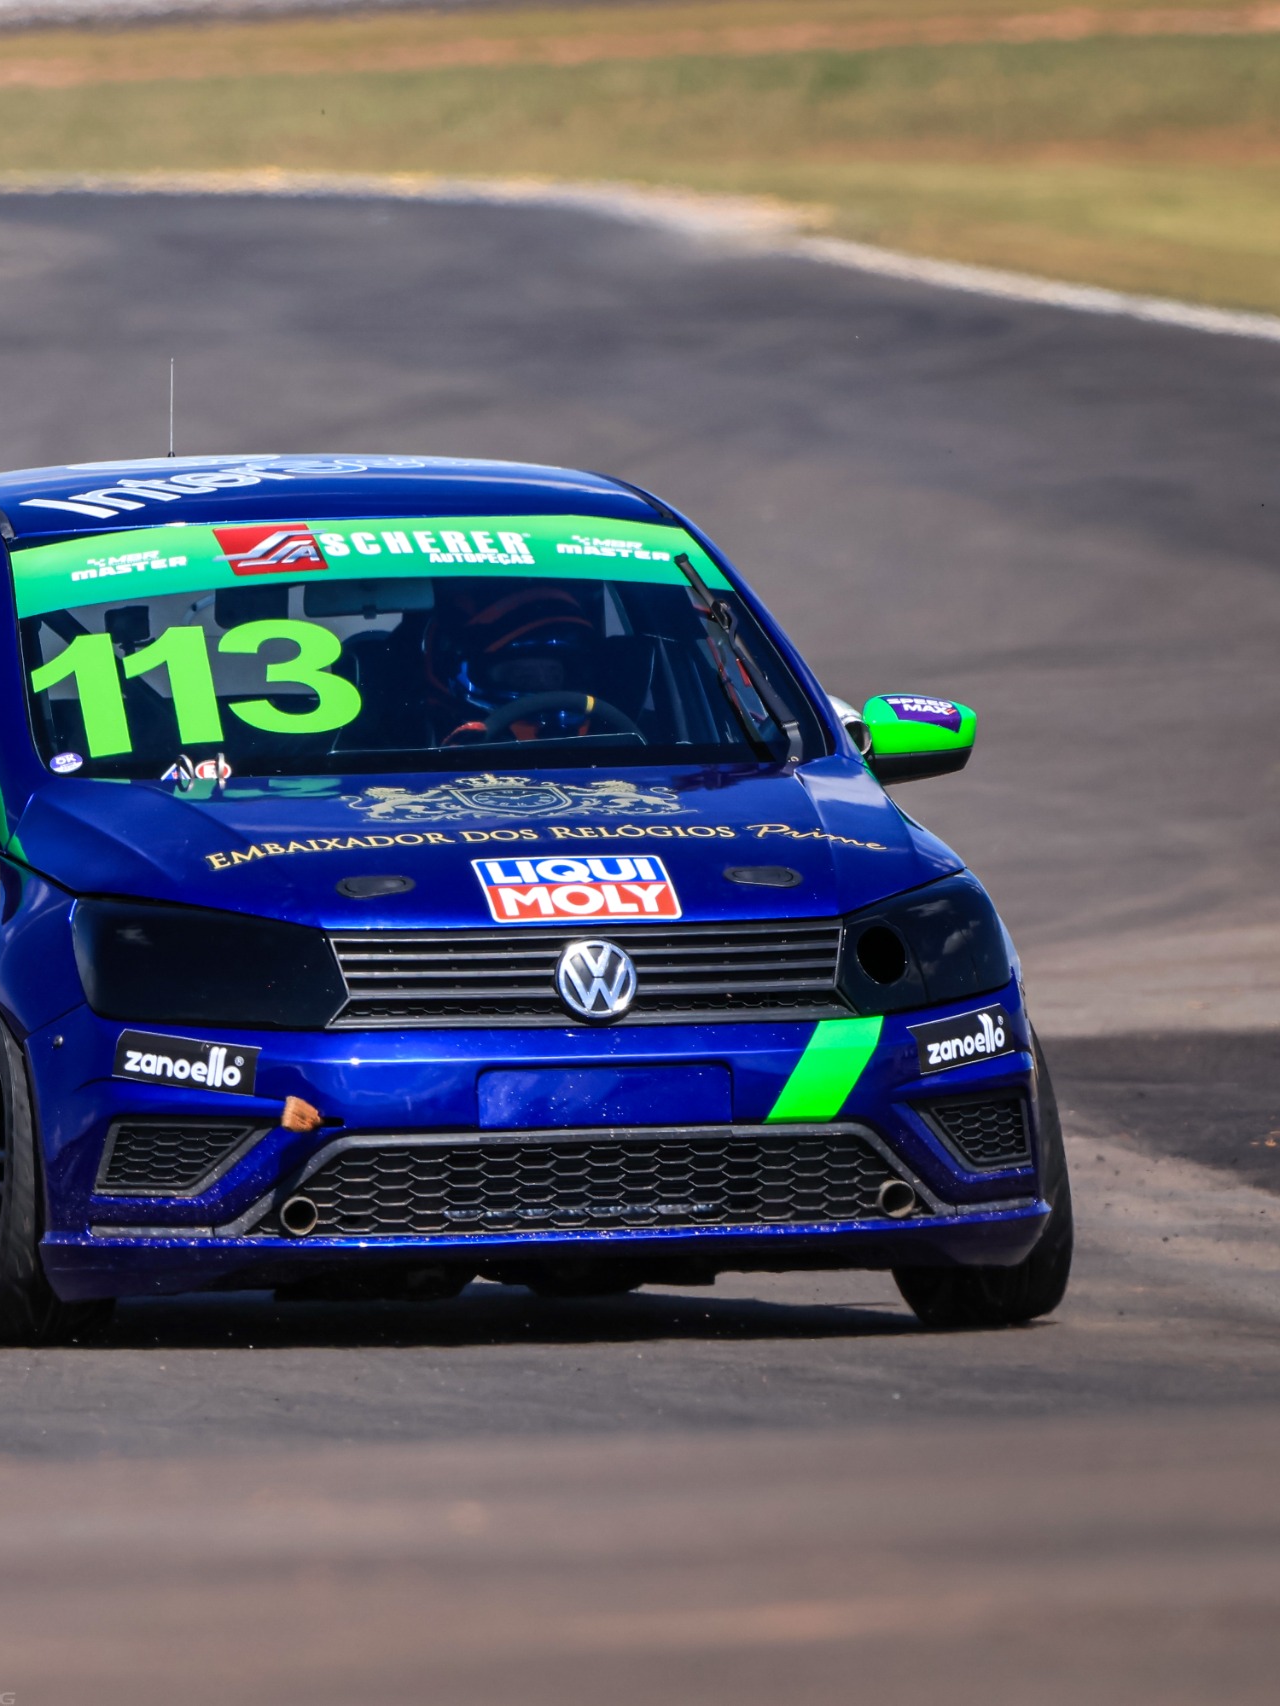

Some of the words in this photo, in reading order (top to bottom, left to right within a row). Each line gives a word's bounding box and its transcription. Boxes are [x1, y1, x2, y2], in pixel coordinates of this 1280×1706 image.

[324, 530, 531, 557] SCHERER
[556, 543, 671, 562] MASTER
[71, 556, 188, 582] MASTER
[429, 552, 536, 566] AUTOPEÇAS
[30, 619, 362, 758] 113
[886, 697, 954, 710] SPEED
[902, 703, 950, 716] MAX
[205, 832, 455, 870] EMBAIXADOR
[459, 829, 539, 843] DOS
[548, 824, 736, 839] RELÓGIOS
[742, 823, 888, 851] Prime
[484, 857, 658, 885] LIQUI
[497, 883, 667, 917] MOLY
[926, 1012, 1006, 1065] zanoello
[123, 1046, 242, 1088] zanoello
